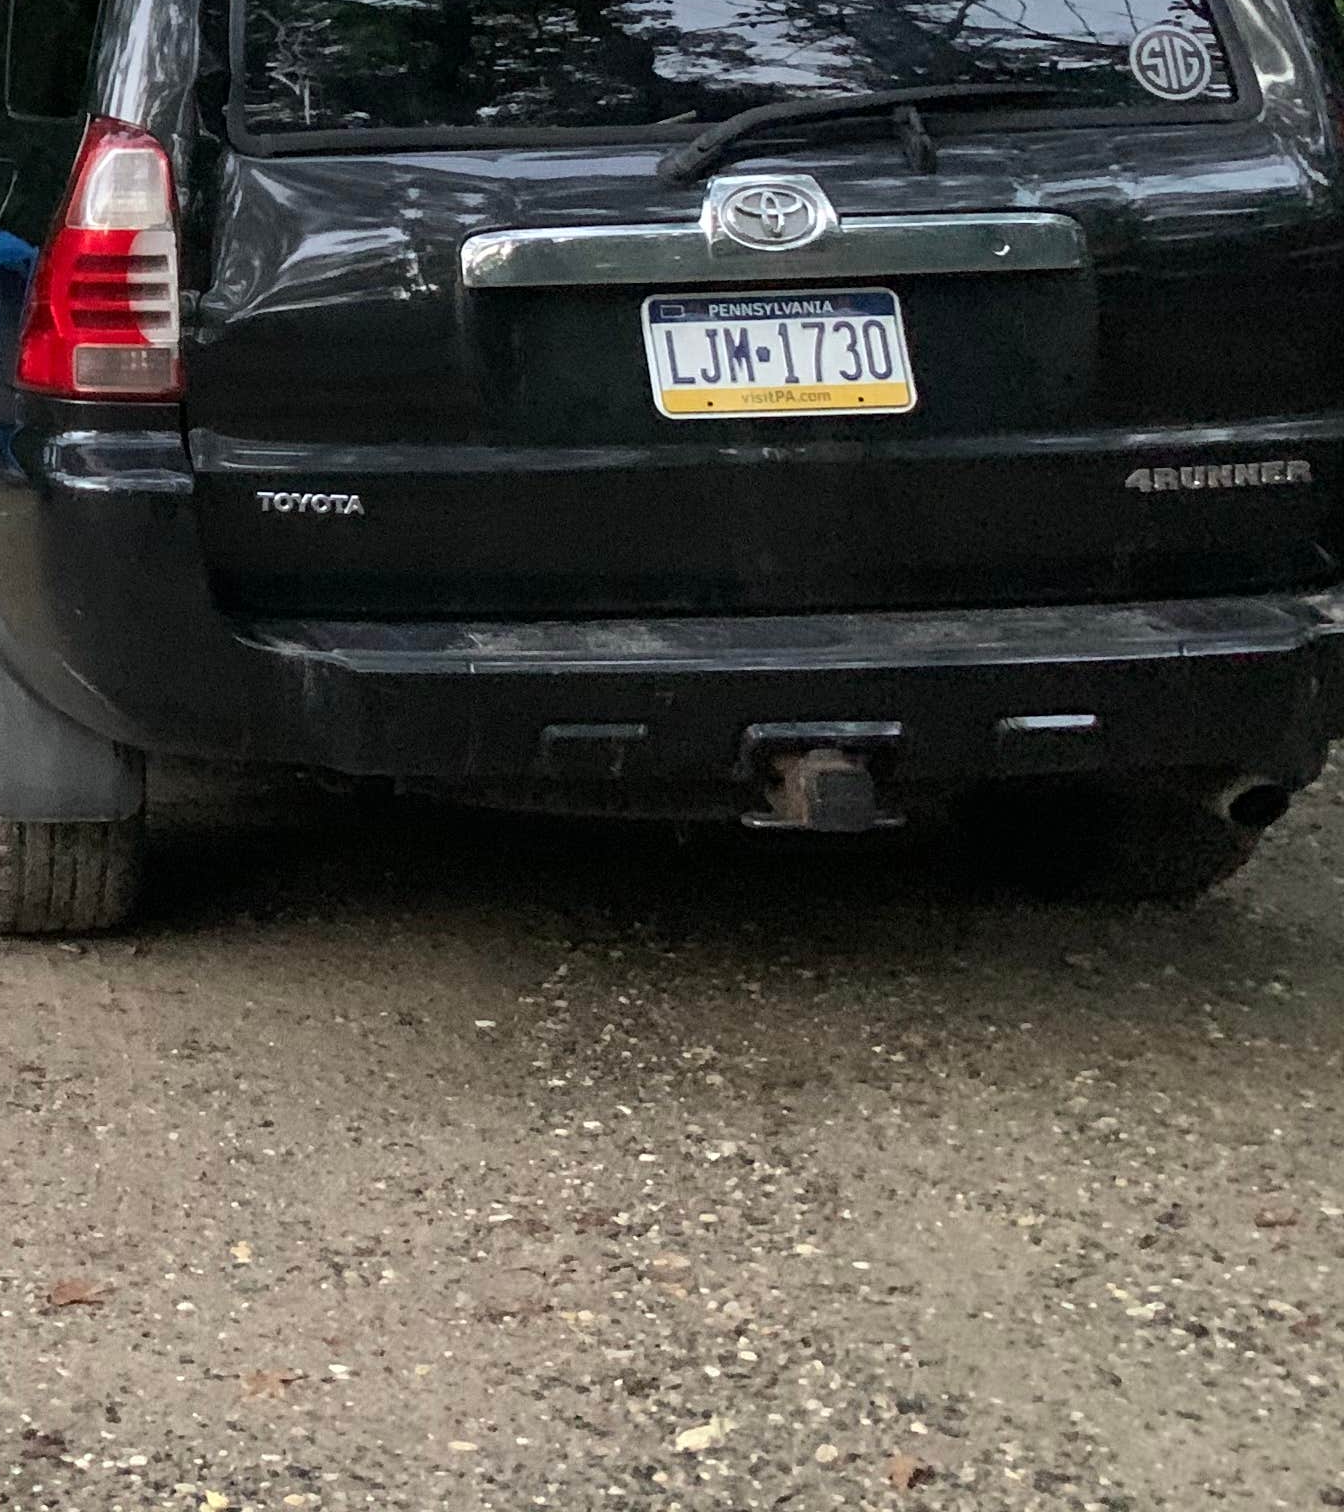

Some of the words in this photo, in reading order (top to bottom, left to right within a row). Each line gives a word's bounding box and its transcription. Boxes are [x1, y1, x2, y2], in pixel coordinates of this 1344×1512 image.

[1139, 32, 1202, 92] SIG
[708, 300, 834, 318] PENNSYLVANIA
[665, 326, 756, 385] LJM
[777, 319, 893, 384] 1730
[741, 389, 832, 405] visitPA.com
[1124, 460, 1312, 493] 4RUNNER
[256, 491, 365, 515] TOYOTA
